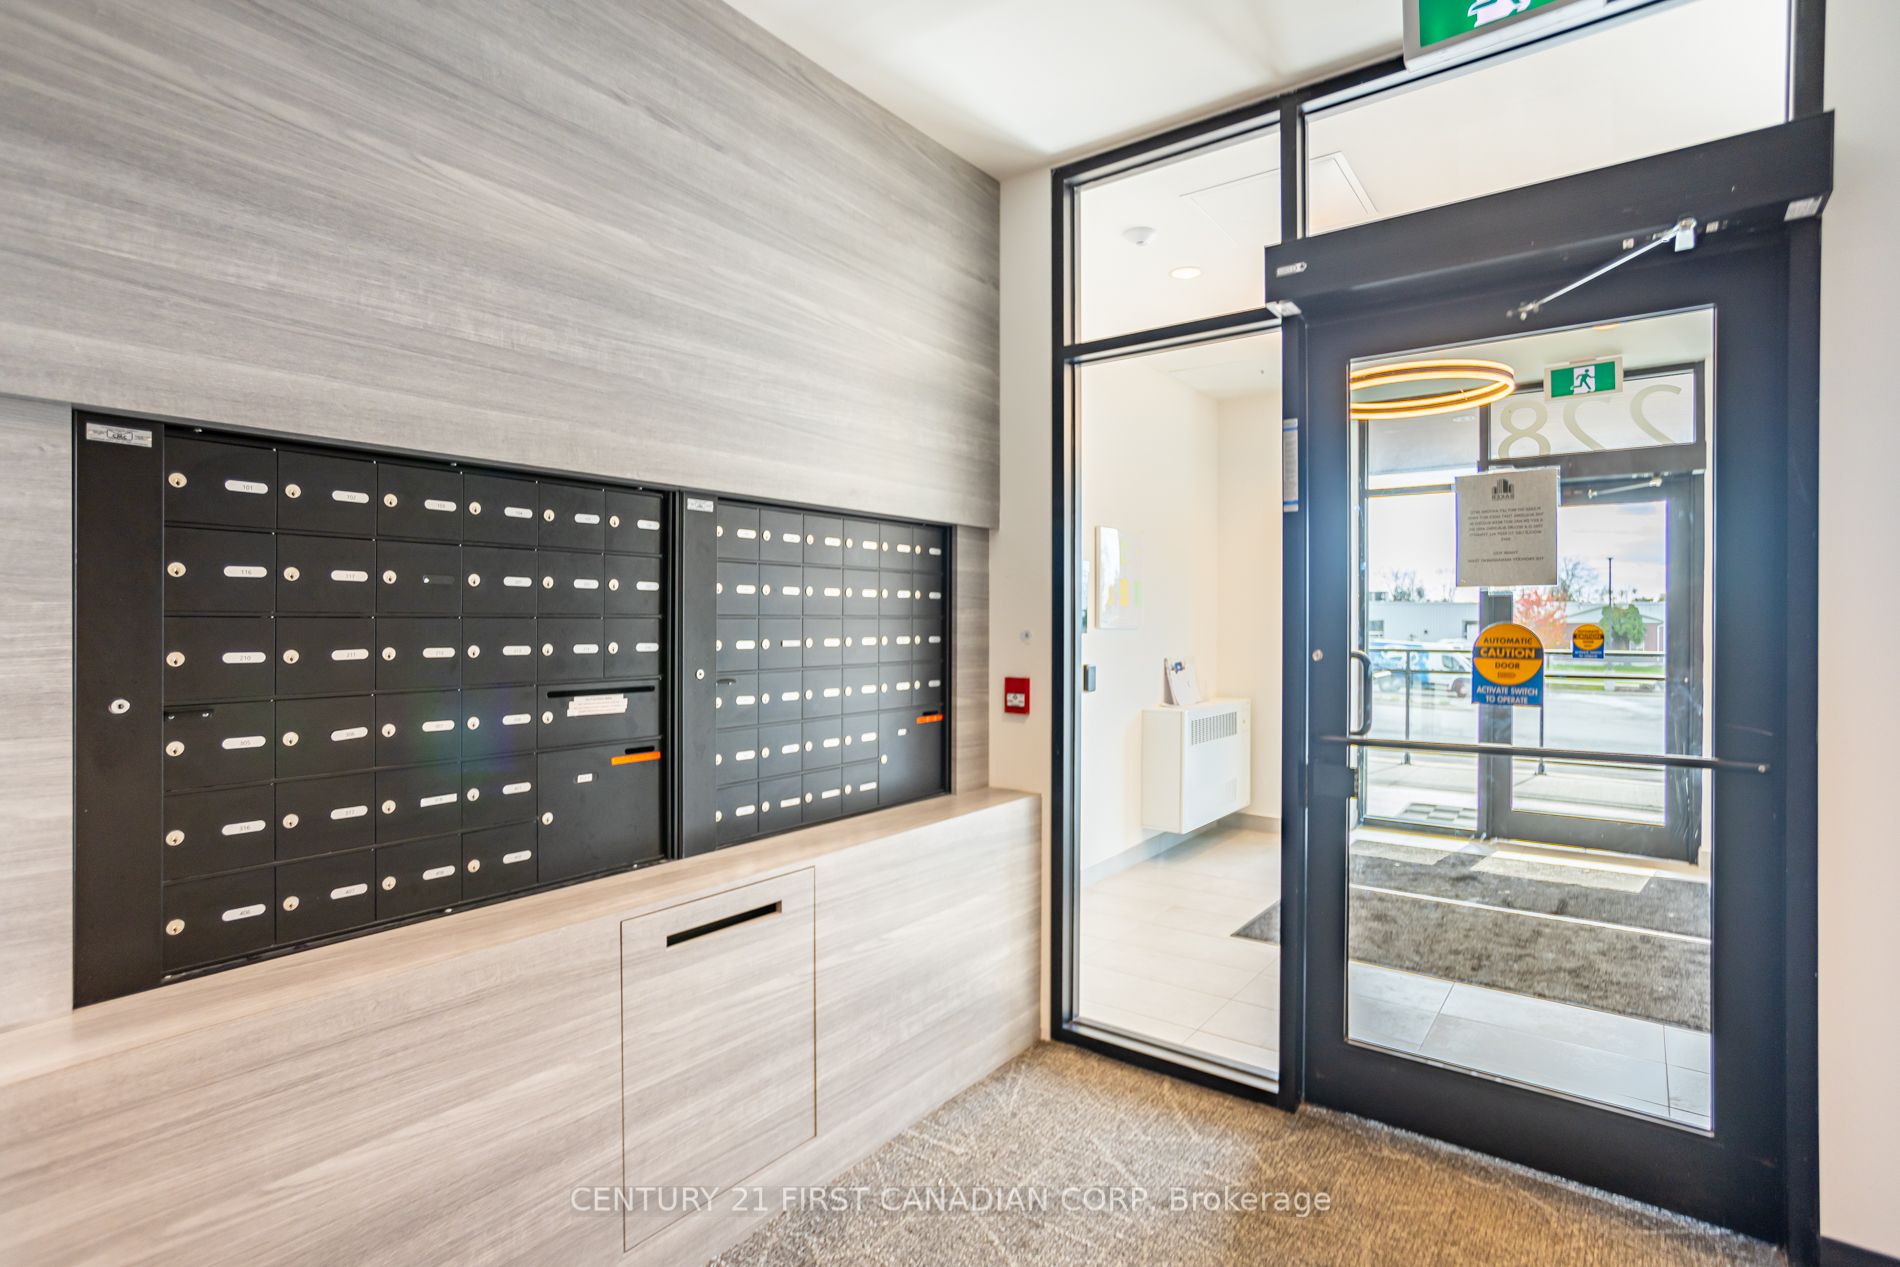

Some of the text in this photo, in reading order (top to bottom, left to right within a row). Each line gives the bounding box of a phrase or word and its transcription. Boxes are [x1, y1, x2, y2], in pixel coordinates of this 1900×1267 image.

[1483, 637, 1533, 646] AUTOMATIC
[1479, 648, 1537, 659] CAUTION
[1494, 662, 1520, 670] DOOR
[1476, 685, 1539, 696] ACTIVATE SWITCH
[1485, 695, 1528, 704] TO OPERATE
